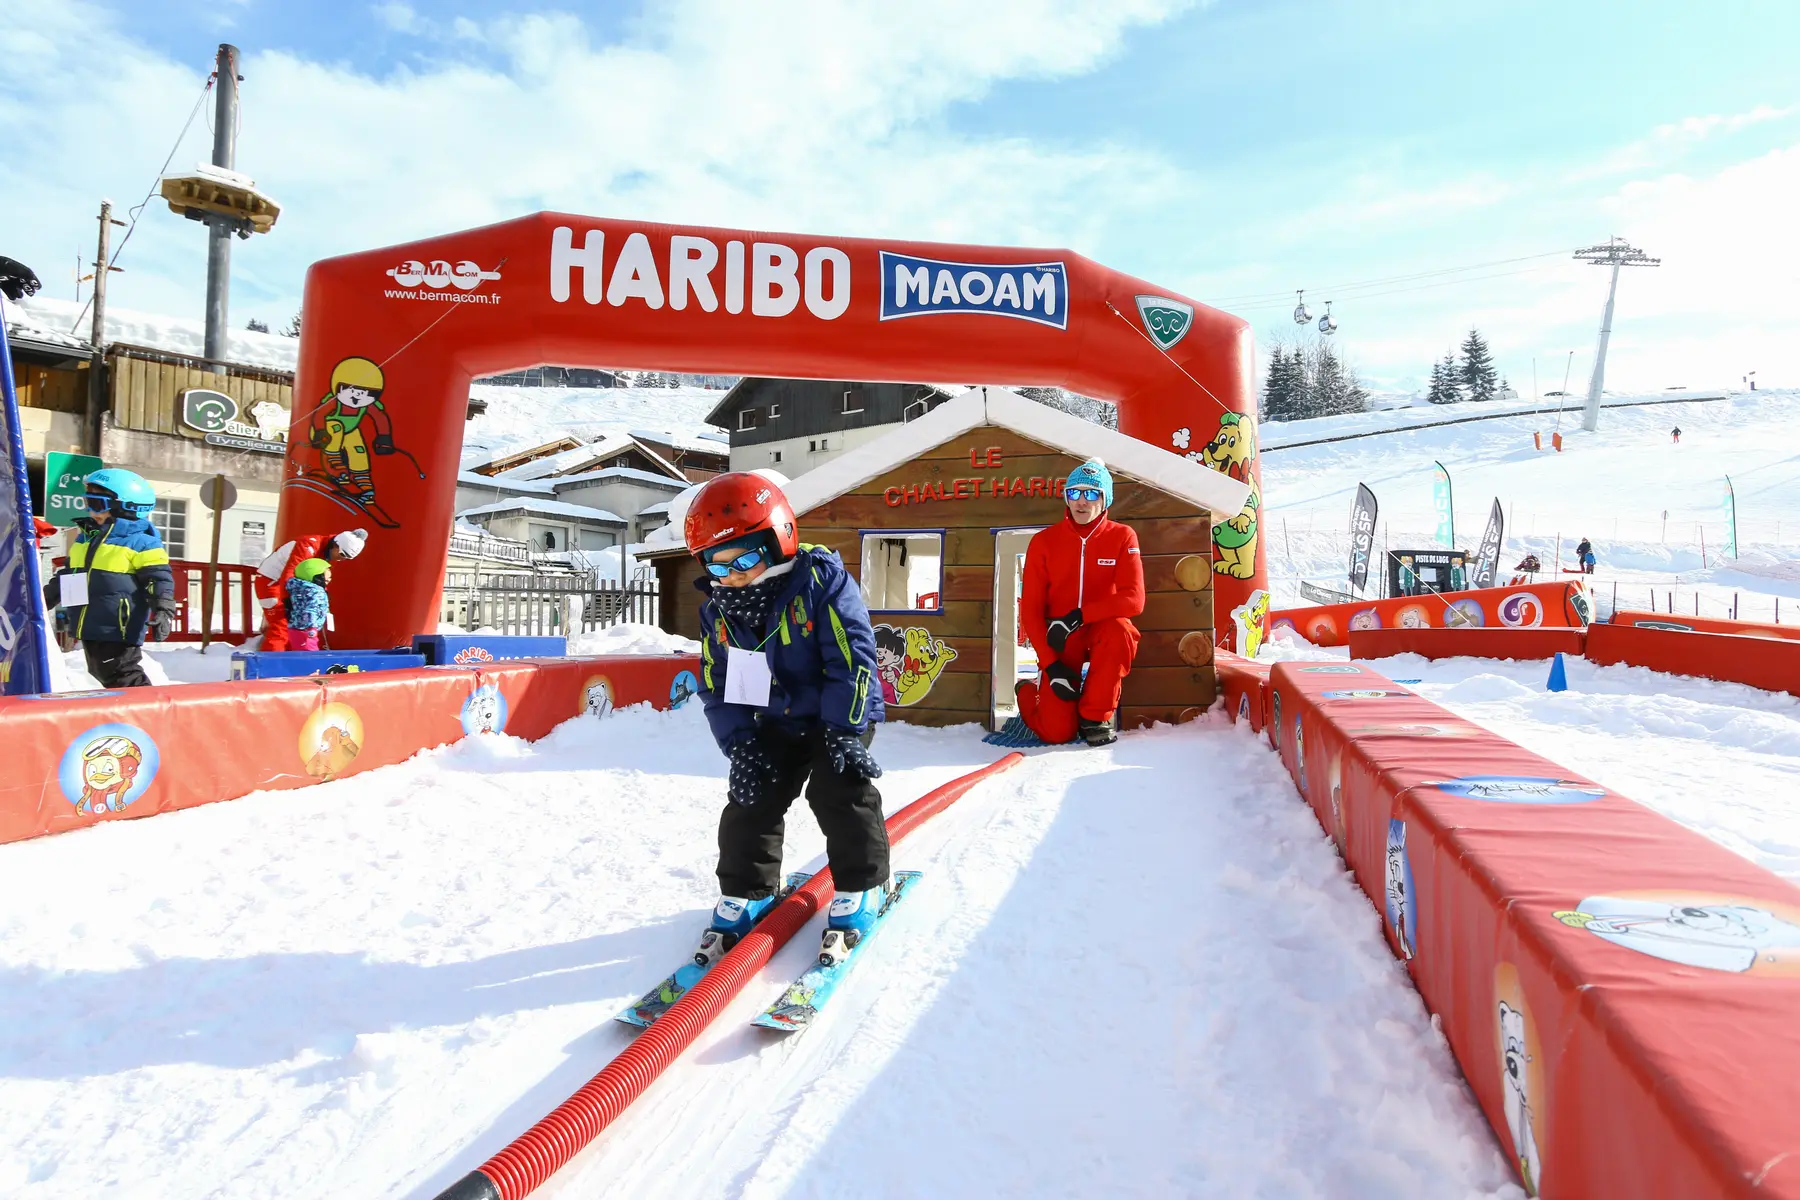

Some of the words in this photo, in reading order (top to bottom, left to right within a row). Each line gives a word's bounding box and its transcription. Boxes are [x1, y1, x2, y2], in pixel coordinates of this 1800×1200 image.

[550, 226, 851, 320] HARIBO
[384, 289, 501, 304] www.bermacom.fr
[895, 263, 1056, 316] MAOAM
[211, 434, 287, 452] Tyrolienn
[970, 447, 1003, 468] LE
[884, 479, 985, 507] CHALET
[992, 477, 1067, 498] HARIB
[50, 494, 86, 510] STO
[1415, 554, 1429, 563] PISTE
[1429, 555, 1435, 563] DE
[1436, 555, 1449, 563] LUGE
[453, 647, 494, 664] HARIBO
